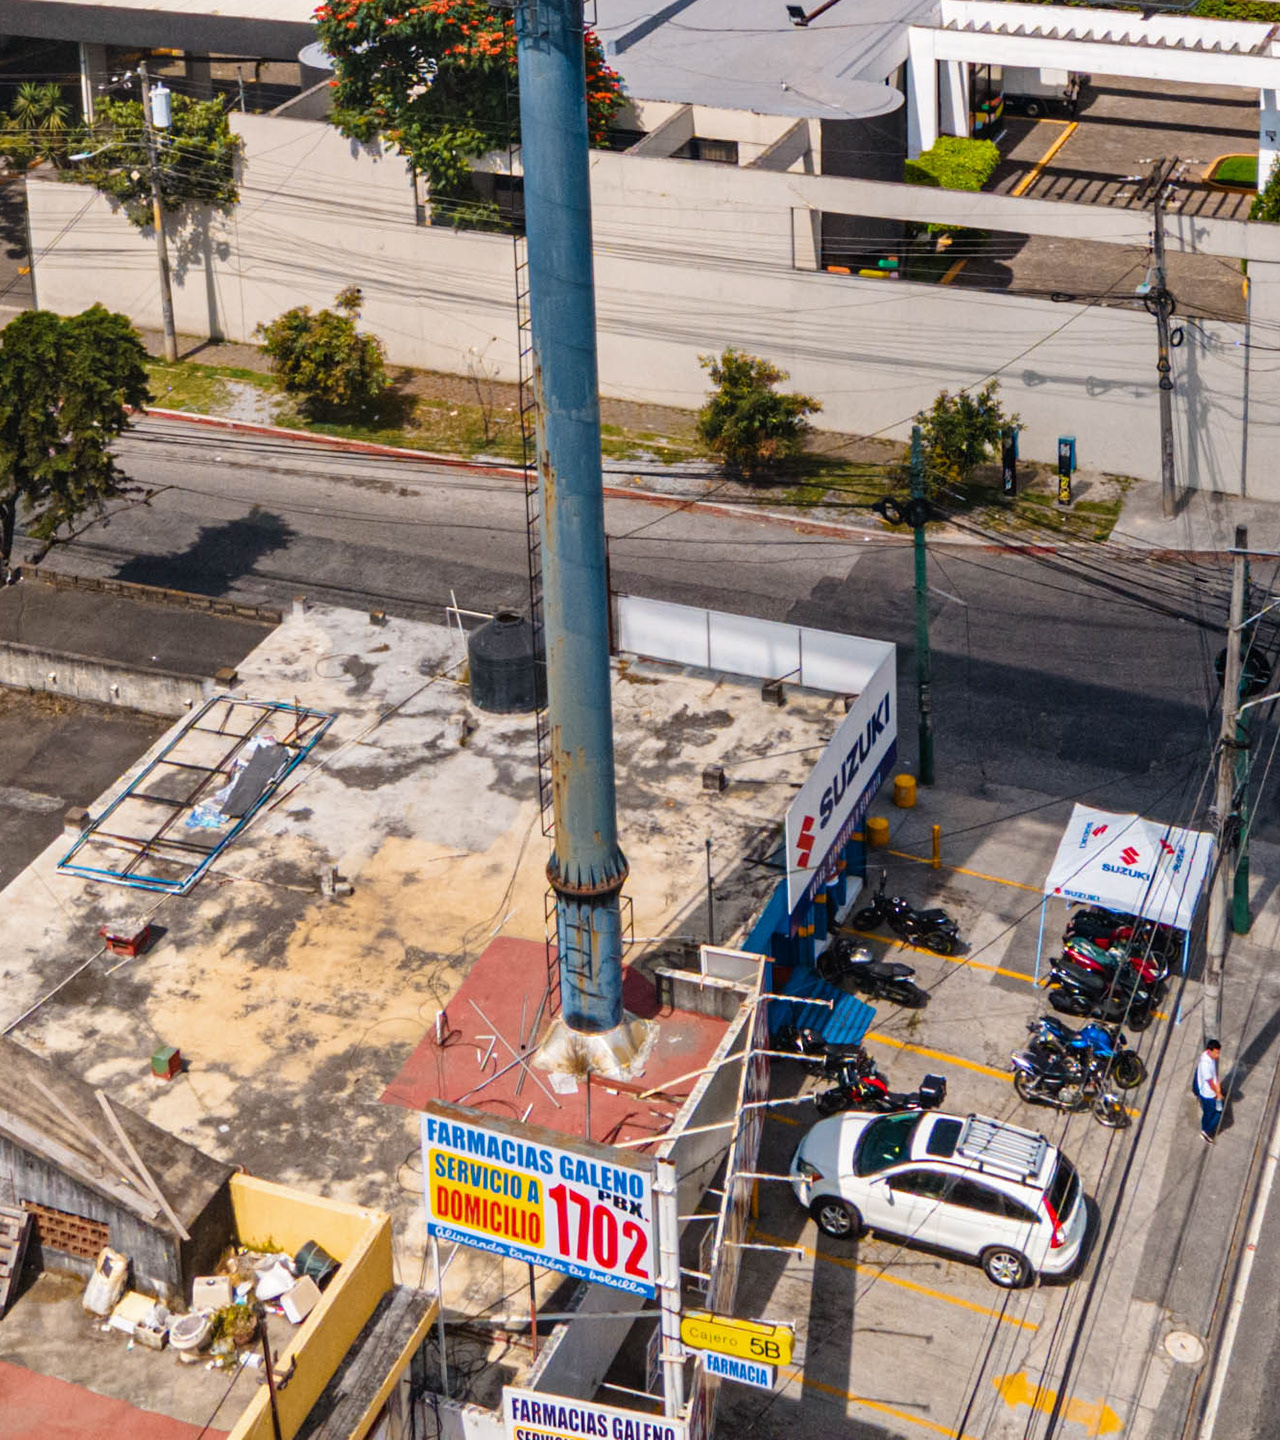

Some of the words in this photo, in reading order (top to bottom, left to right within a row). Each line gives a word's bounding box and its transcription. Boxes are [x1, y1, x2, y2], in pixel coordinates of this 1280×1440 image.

[819, 690, 890, 831] SUZUKI
[1101, 862, 1150, 882] SUZUKI
[1063, 888, 1101, 902] SUZUKI
[426, 1117, 554, 1175] FARMACIAS
[559, 1155, 644, 1200] GALENO
[435, 1152, 522, 1200] SERVICIO
[527, 1180, 540, 1205] A
[436, 1184, 541, 1245] DOMICILIO
[598, 1189, 650, 1223] PBX.
[548, 1182, 650, 1280] 1702
[508, 1246, 566, 1272] también
[568, 1262, 587, 1278] tu
[589, 1269, 648, 1295] bolsillo
[689, 1327, 738, 1348] Cajero
[750, 1337, 781, 1360] 5B
[706, 1353, 769, 1386] FARMACIA
[511, 1397, 609, 1439] FARMACIAS
